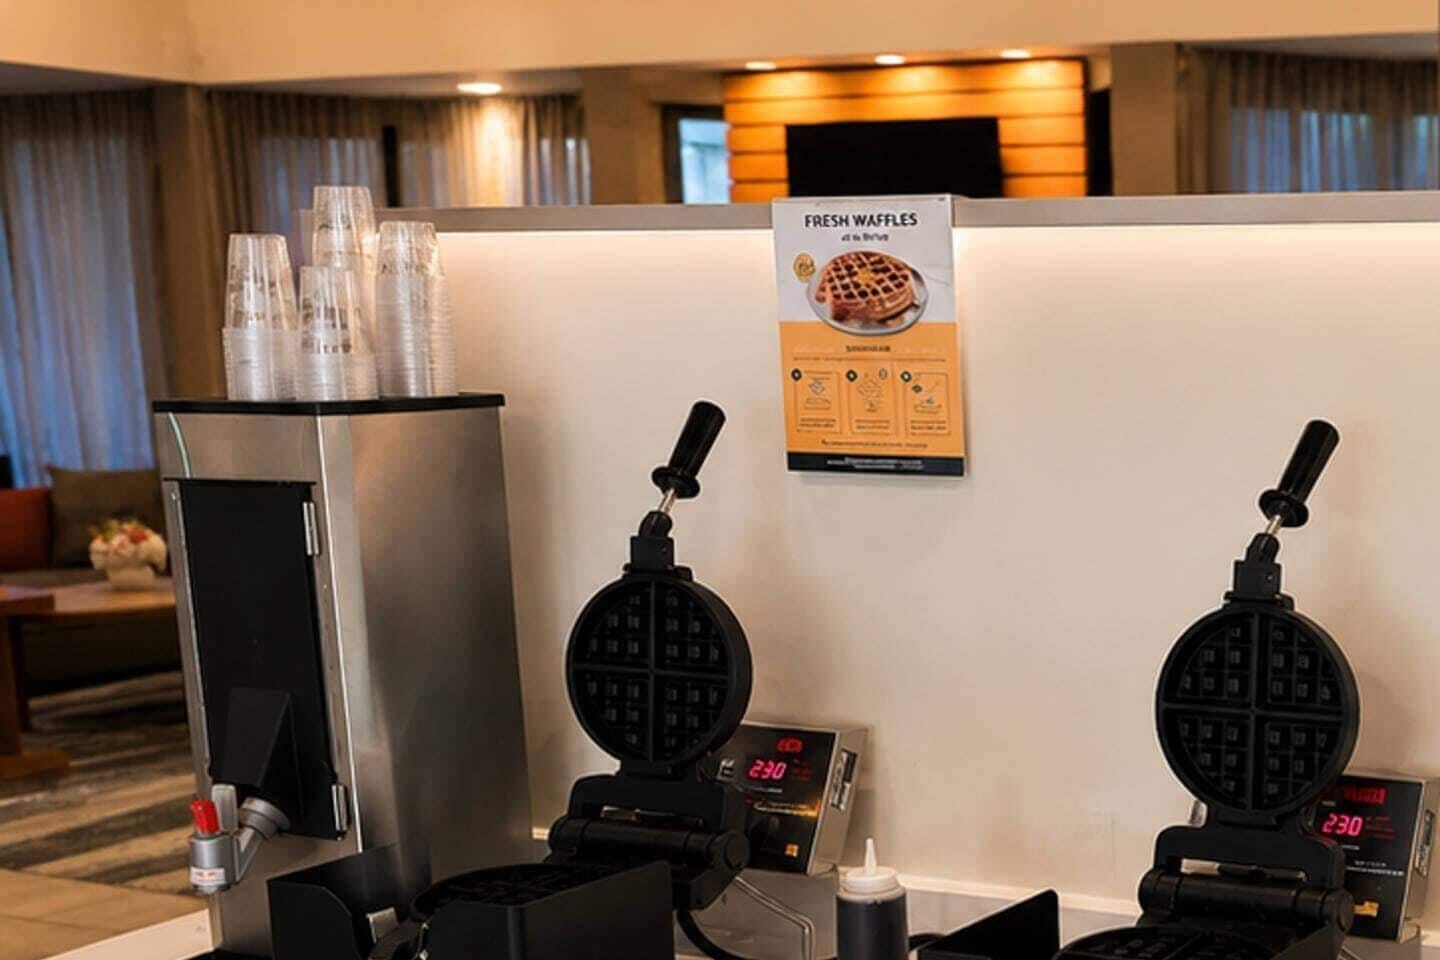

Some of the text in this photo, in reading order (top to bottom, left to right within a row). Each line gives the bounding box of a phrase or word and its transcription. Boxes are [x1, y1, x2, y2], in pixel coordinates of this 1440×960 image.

[804, 212, 918, 228] FRESH WAFFLES
[748, 759, 787, 779] 230
[1322, 812, 1363, 836] 230
